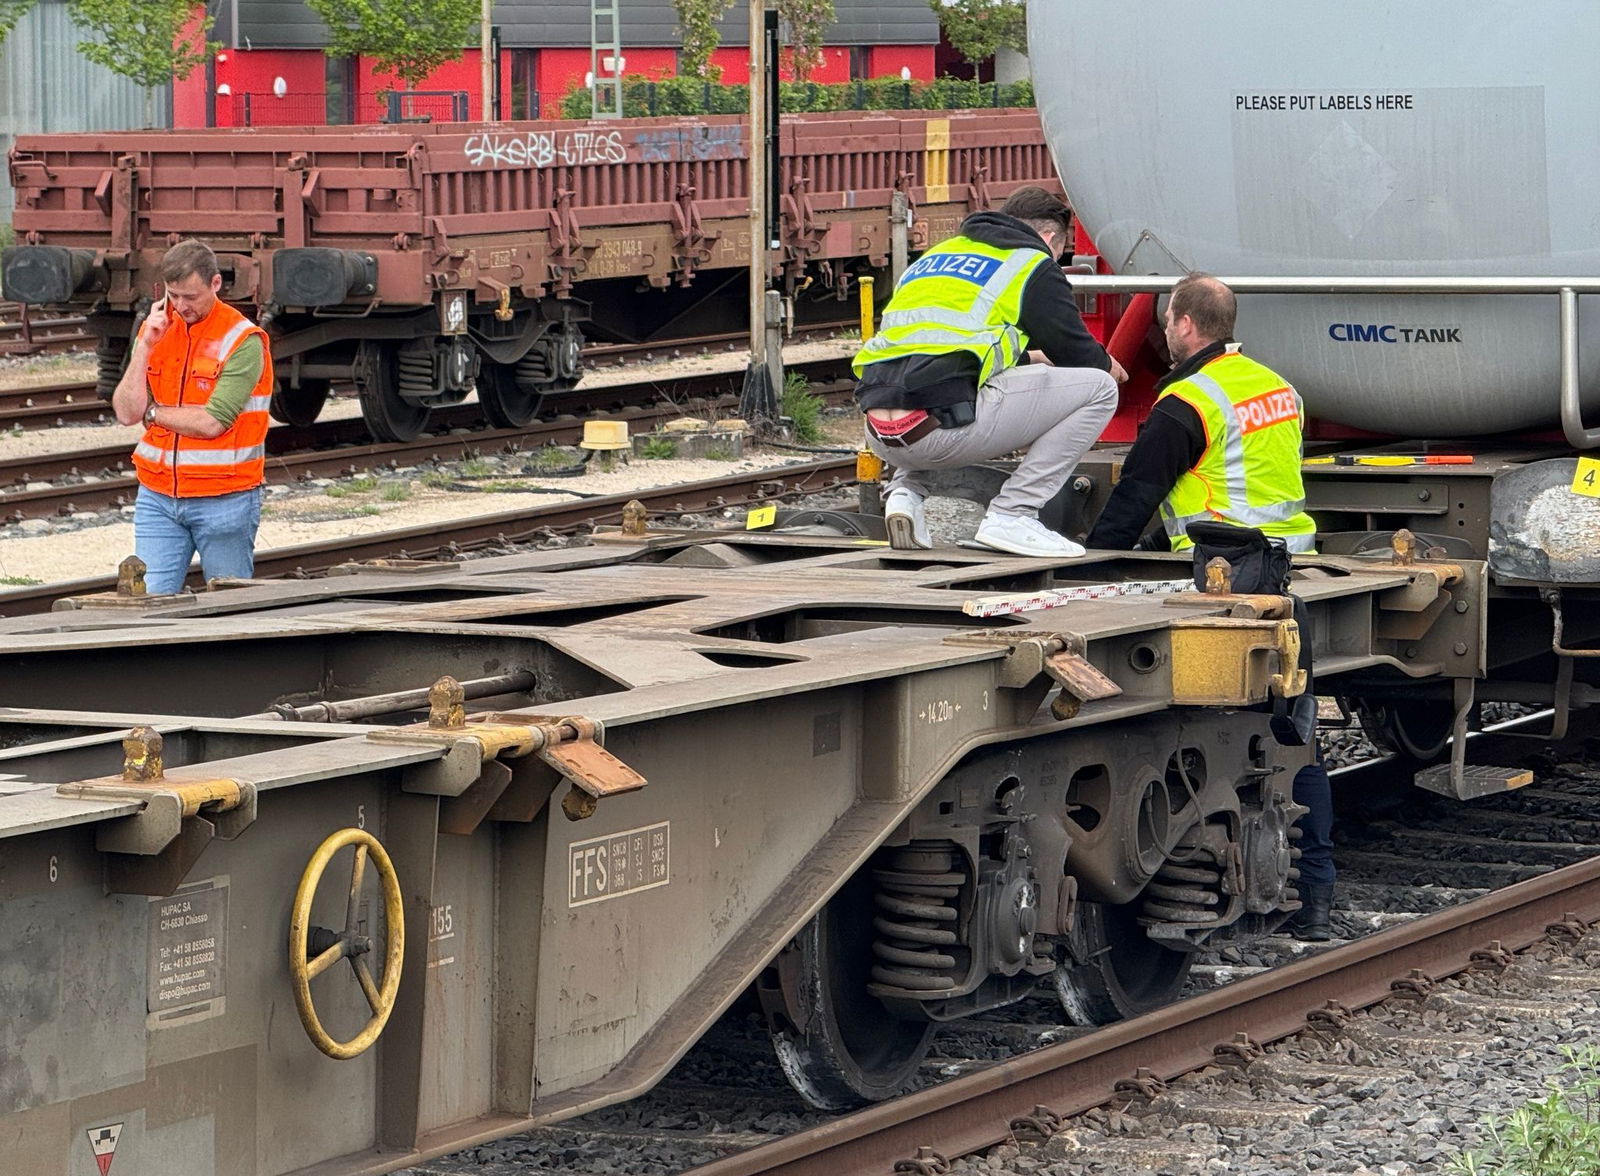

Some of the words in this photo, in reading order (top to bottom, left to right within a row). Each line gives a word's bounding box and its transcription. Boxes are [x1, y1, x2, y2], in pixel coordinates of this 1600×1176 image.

[1236, 95, 1286, 110] PLEASE
[1290, 95, 1316, 110] PUT
[1320, 95, 1372, 110] LABELS
[1376, 94, 1413, 110] HERE
[1328, 323, 1397, 343] CIMC
[1399, 328, 1462, 343] TANK
[1583, 469, 1596, 487] 4
[758, 512, 765, 522] 1
[982, 690, 989, 711] 3
[358, 804, 365, 829] 5
[49, 855, 58, 882] 6
[572, 845, 607, 898] FFS
[161, 903, 182, 917] HUPAC
[182, 901, 192, 912] SA
[432, 905, 453, 935] 155
[173, 944, 183, 954] +41
[173, 957, 183, 969] +41
[160, 969, 205, 985] www.hupac.com
